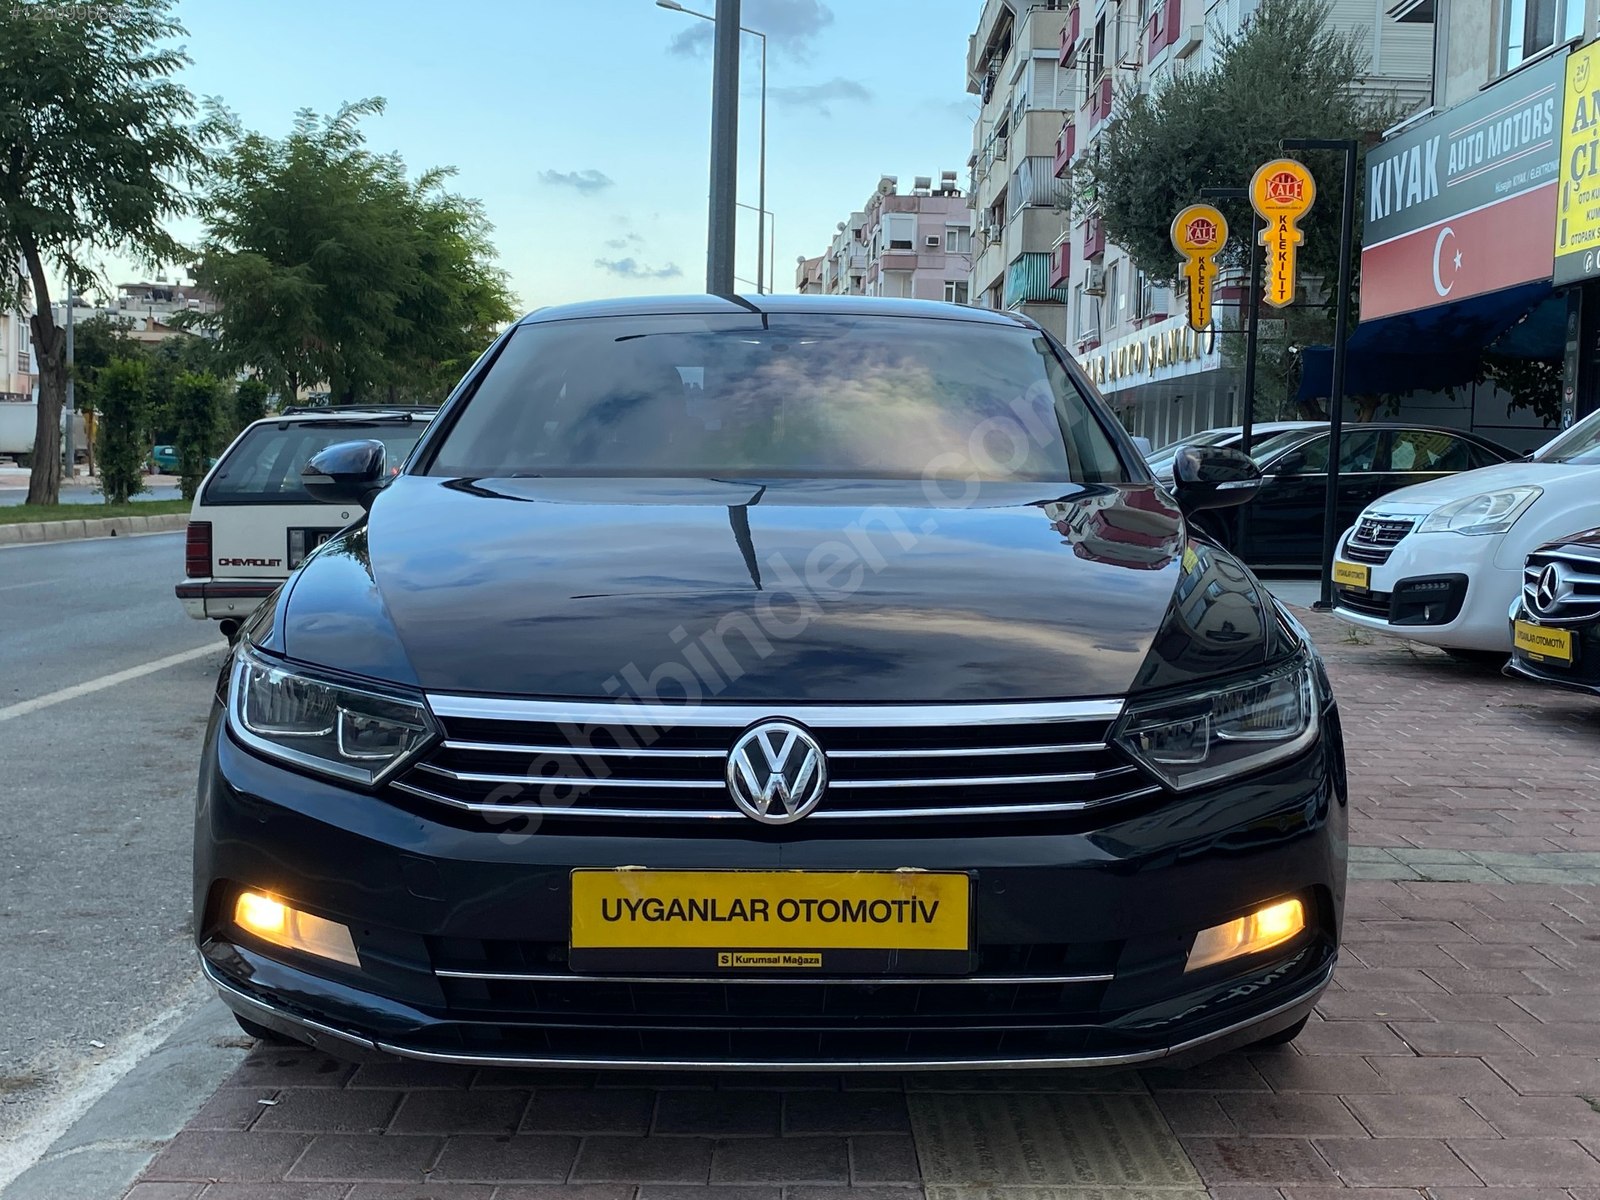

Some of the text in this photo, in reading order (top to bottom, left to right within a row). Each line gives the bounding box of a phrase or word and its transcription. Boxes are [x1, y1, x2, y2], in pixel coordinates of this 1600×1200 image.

[1370, 97, 1554, 222] KIYAK AUTO MOTORS
[1266, 180, 1303, 201] KALE
[1186, 226, 1217, 243] KALE
[1571, 228, 1596, 246] OTOPARK
[218, 558, 282, 567] CHEVROLET
[1535, 635, 1565, 649] OTOMOTİV
[601, 895, 940, 924] UYGANLAR OTOMOTİV
[720, 955, 820, 966] S Kurumsal Mağaza
